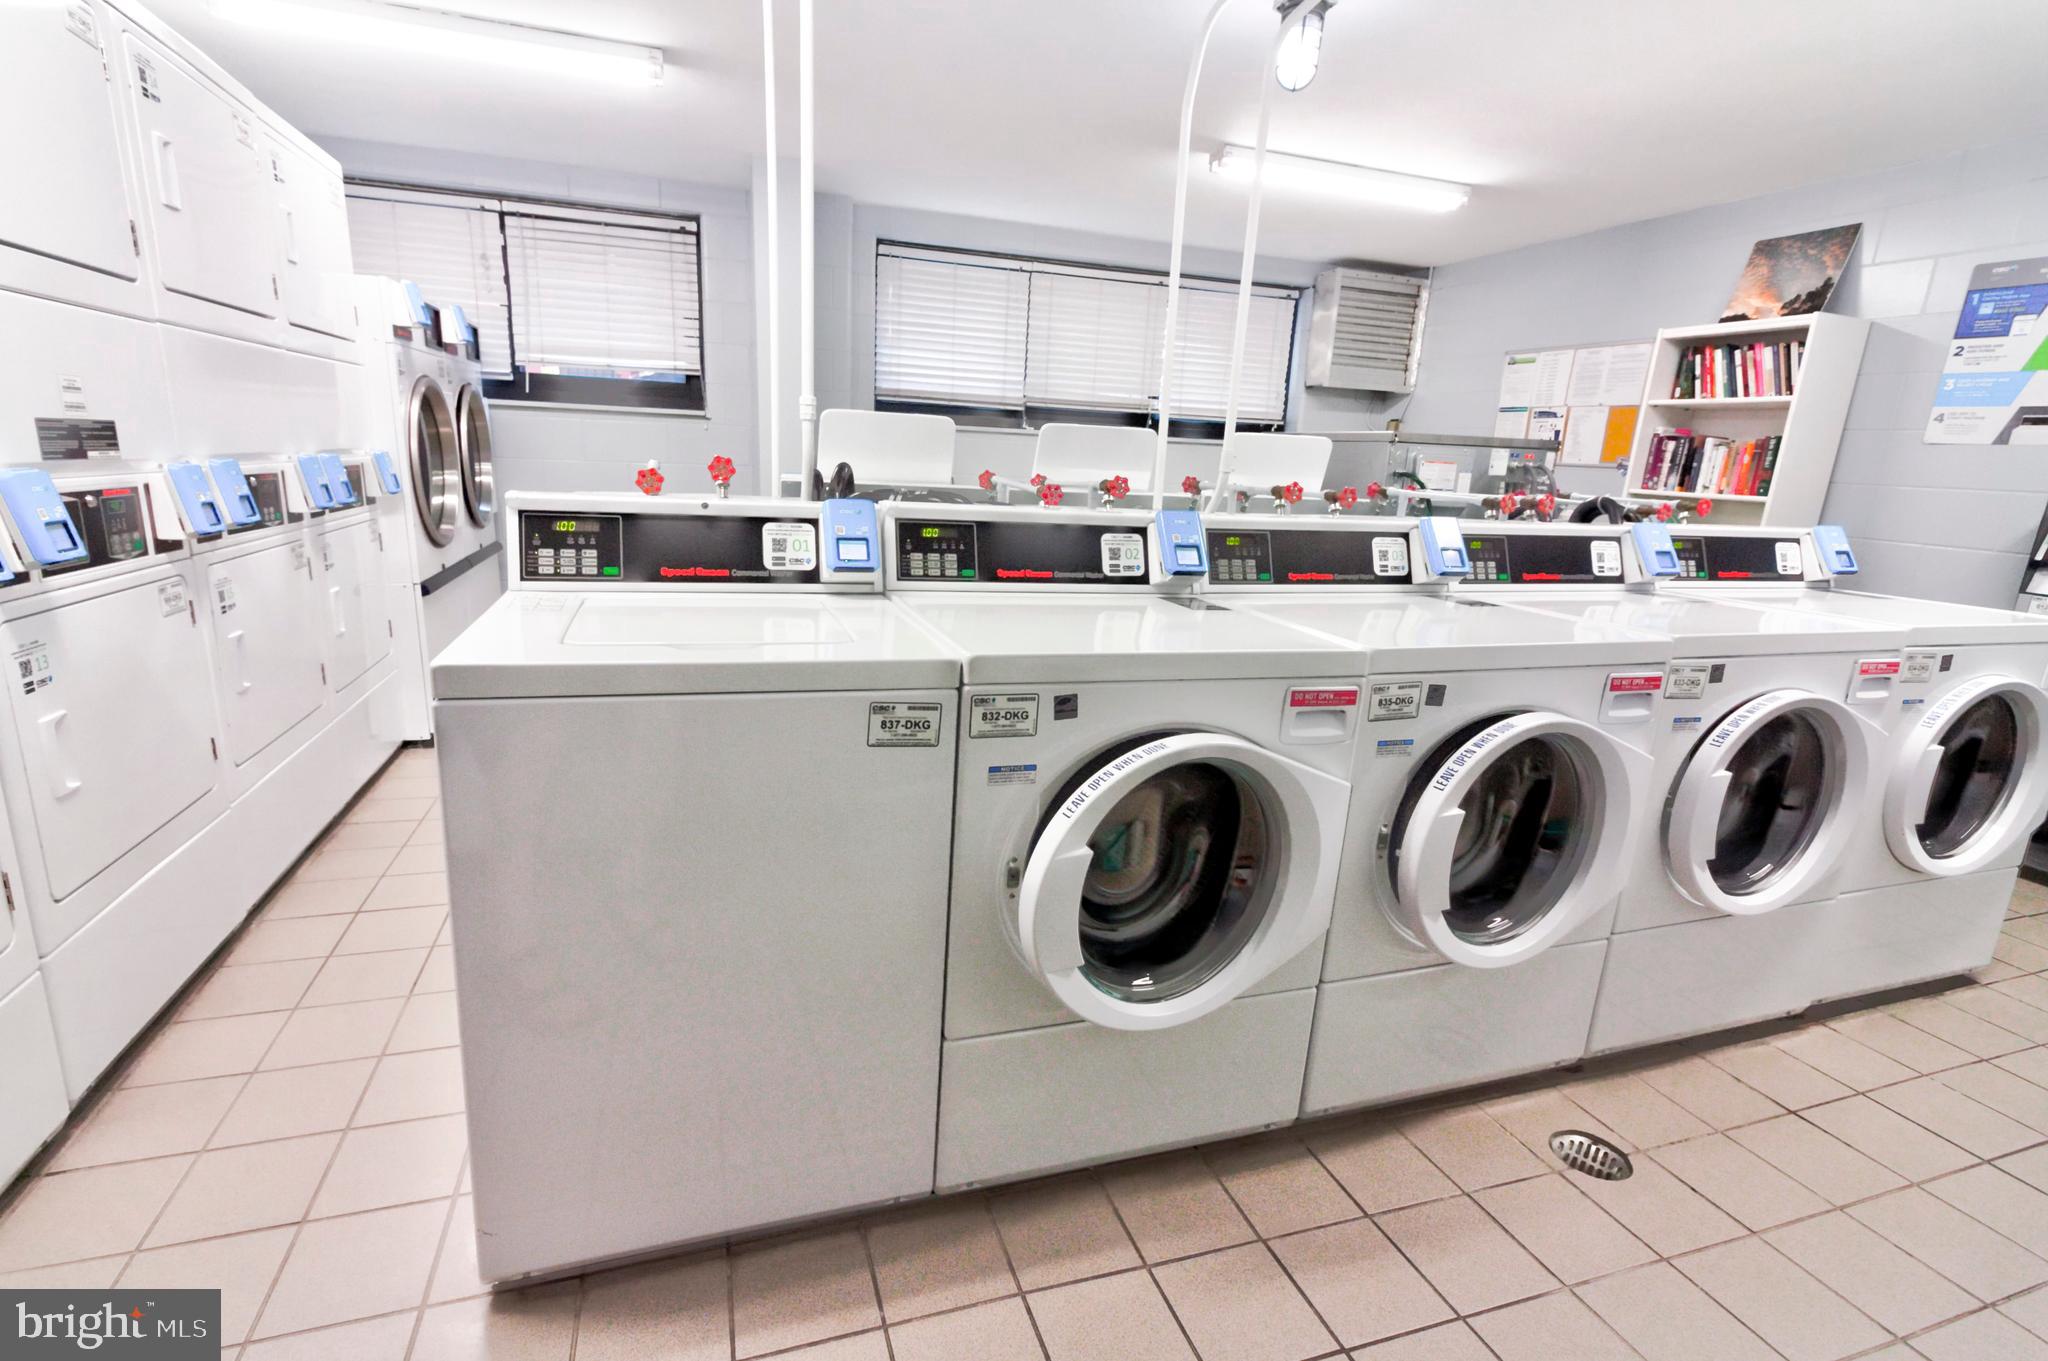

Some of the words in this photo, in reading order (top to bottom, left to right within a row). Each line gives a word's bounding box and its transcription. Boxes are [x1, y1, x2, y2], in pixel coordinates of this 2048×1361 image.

[1972, 293, 1980, 305] 1
[1953, 346, 1965, 357] 2
[1943, 379, 1955, 391] 3
[1933, 413, 1945, 424] 4
[792, 539, 810, 552] 01
[1125, 548, 1140, 560] 02
[1391, 550, 1405, 561] 03
[35, 654, 49, 672] 13
[1295, 692, 1304, 700] DO
[1305, 692, 1317, 700] NOT
[1378, 696, 1413, 707] 835-DKG
[982, 711, 1029, 721] 832-DKG
[880, 720, 931, 730] 837-DKG
[1709, 728, 1734, 748] LEAVE
[1433, 765, 1459, 791] LEAVE
[1453, 747, 1477, 767] OPEN
[1471, 732, 1498, 749] WHEN
[1062, 791, 1089, 819] LEAVE
[1088, 769, 1114, 791] OPEN
[1112, 752, 1143, 771] WHEN
[1142, 742, 1169, 756] DONE
